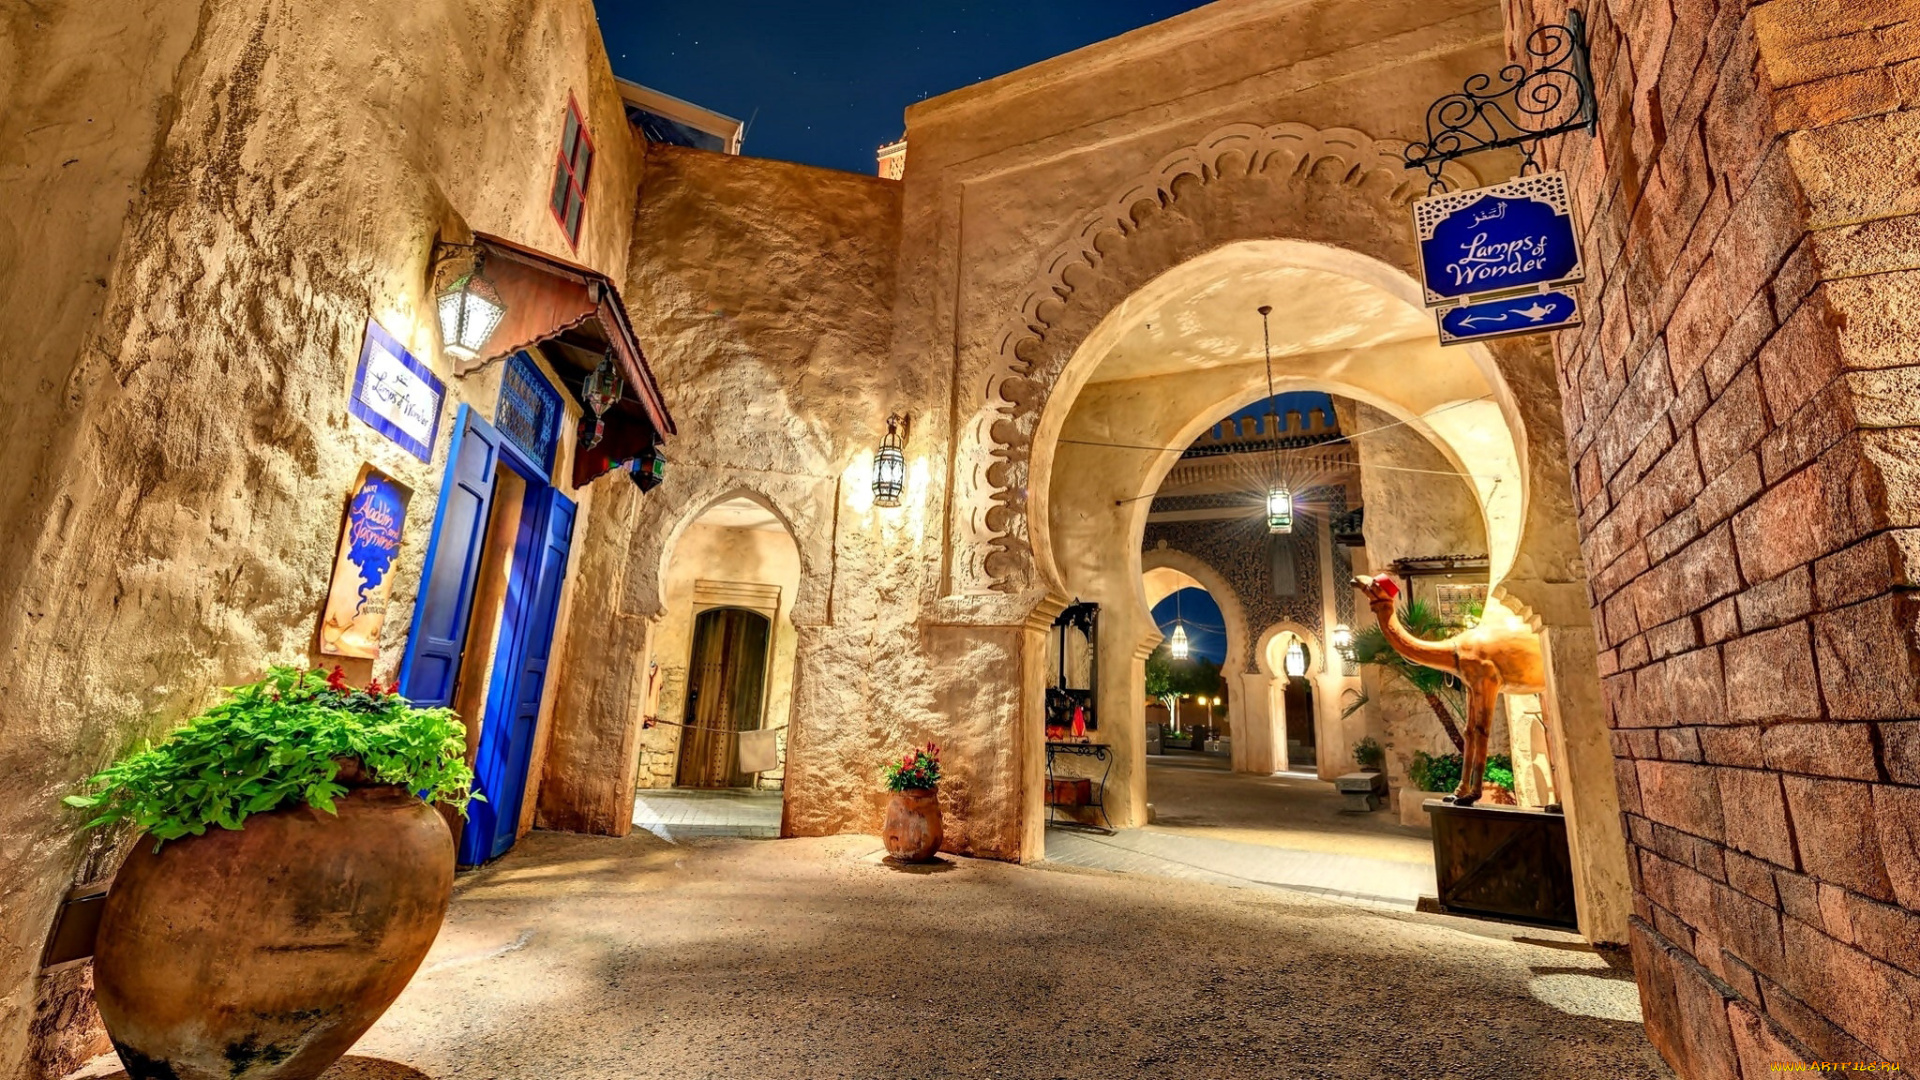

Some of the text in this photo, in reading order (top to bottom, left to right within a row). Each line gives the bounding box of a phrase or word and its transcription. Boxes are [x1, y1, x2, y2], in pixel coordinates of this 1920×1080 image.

[1459, 232, 1548, 265] Lamps of
[1446, 252, 1547, 286] Wonder
[372, 371, 397, 404] Lamps
[404, 393, 429, 427] Wonder
[353, 494, 394, 529] Aladdin
[350, 517, 402, 550] Jasmine
